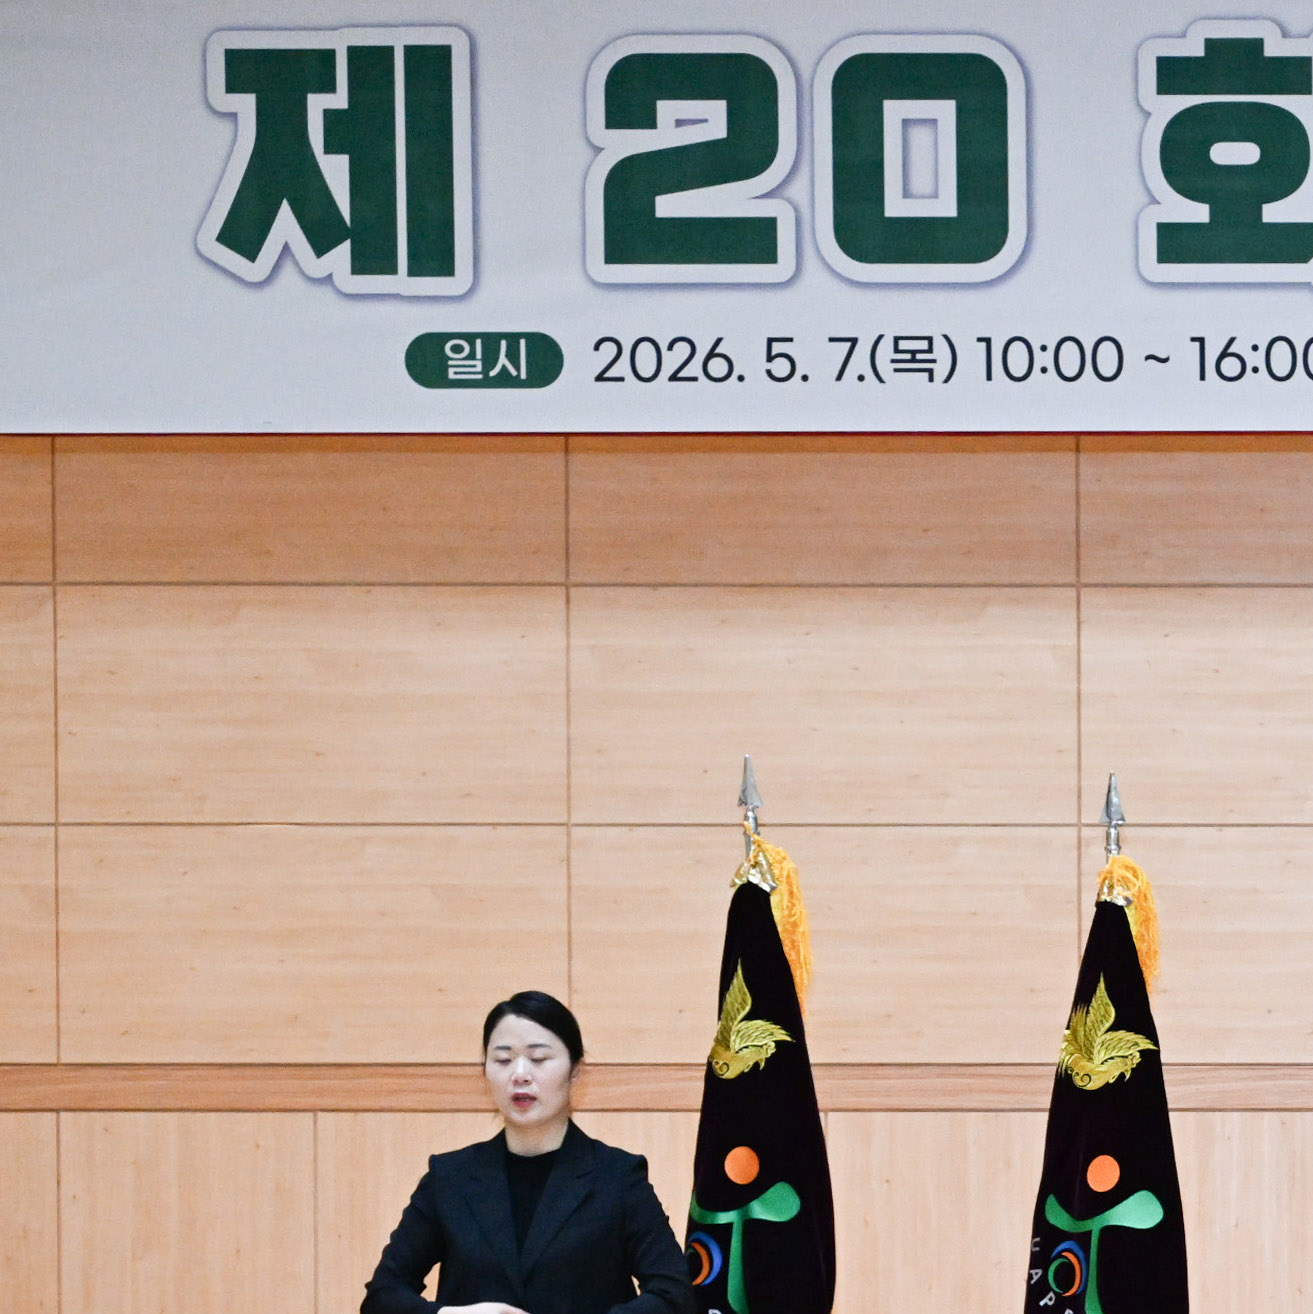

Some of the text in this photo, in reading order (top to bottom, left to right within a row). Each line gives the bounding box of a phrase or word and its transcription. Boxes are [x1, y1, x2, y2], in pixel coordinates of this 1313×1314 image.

[214, 44, 456, 278] 제
[602, 51, 1010, 266] 20
[443, 337, 528, 380] 일시
[592, 335, 746, 384] 2026.
[764, 336, 810, 384] 5.
[827, 333, 959, 384] 7.(목)
[975, 335, 1125, 383] 10:00
